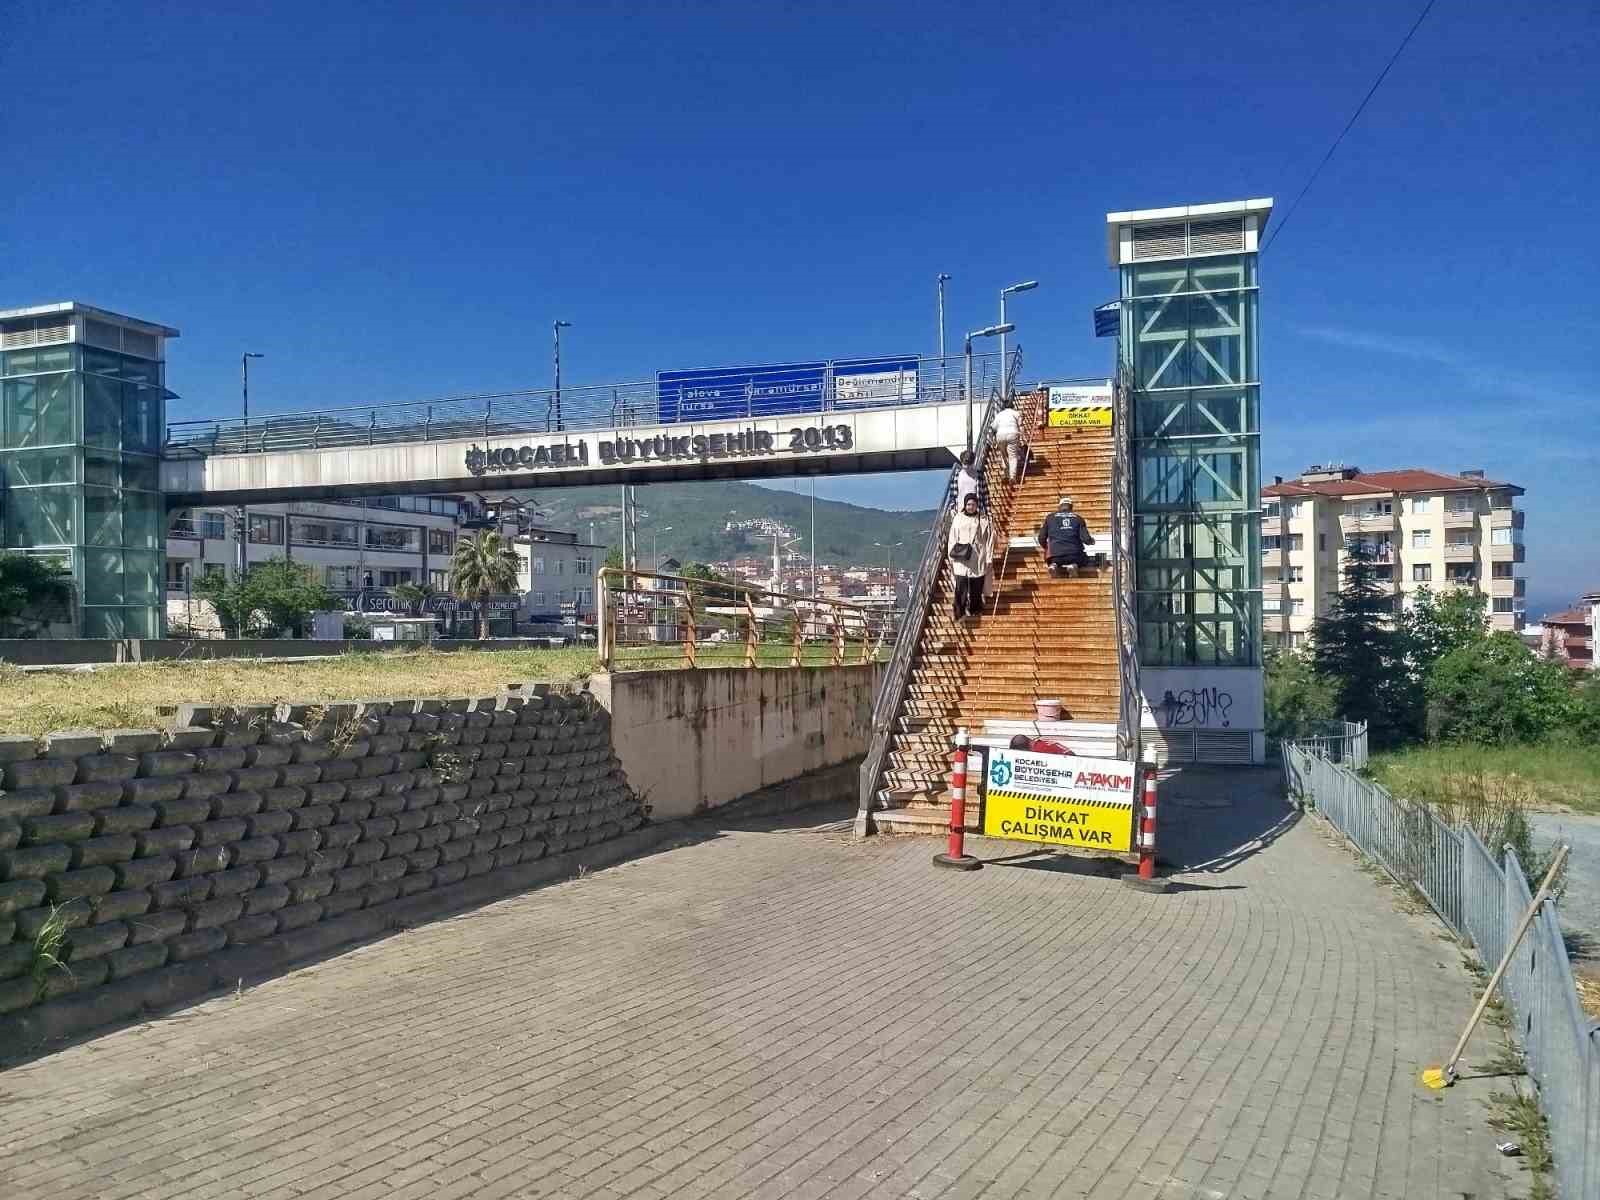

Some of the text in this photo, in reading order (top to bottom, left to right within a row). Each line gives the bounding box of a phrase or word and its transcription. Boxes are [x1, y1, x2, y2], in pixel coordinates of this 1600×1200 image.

[486, 424, 853, 468] KOCAELİ BÜYÜKŞEHİR 2013
[1014, 758, 1048, 767] KOCAELİ
[1014, 766, 1073, 779] BÜYÜKŞEHİR
[1014, 774, 1058, 785] BELEDİYESİ
[1075, 771, 1132, 790] A-TAKIMI
[1025, 806, 1090, 826] DİKKAT
[1001, 820, 1113, 845] ÇALIŞMA VAR
